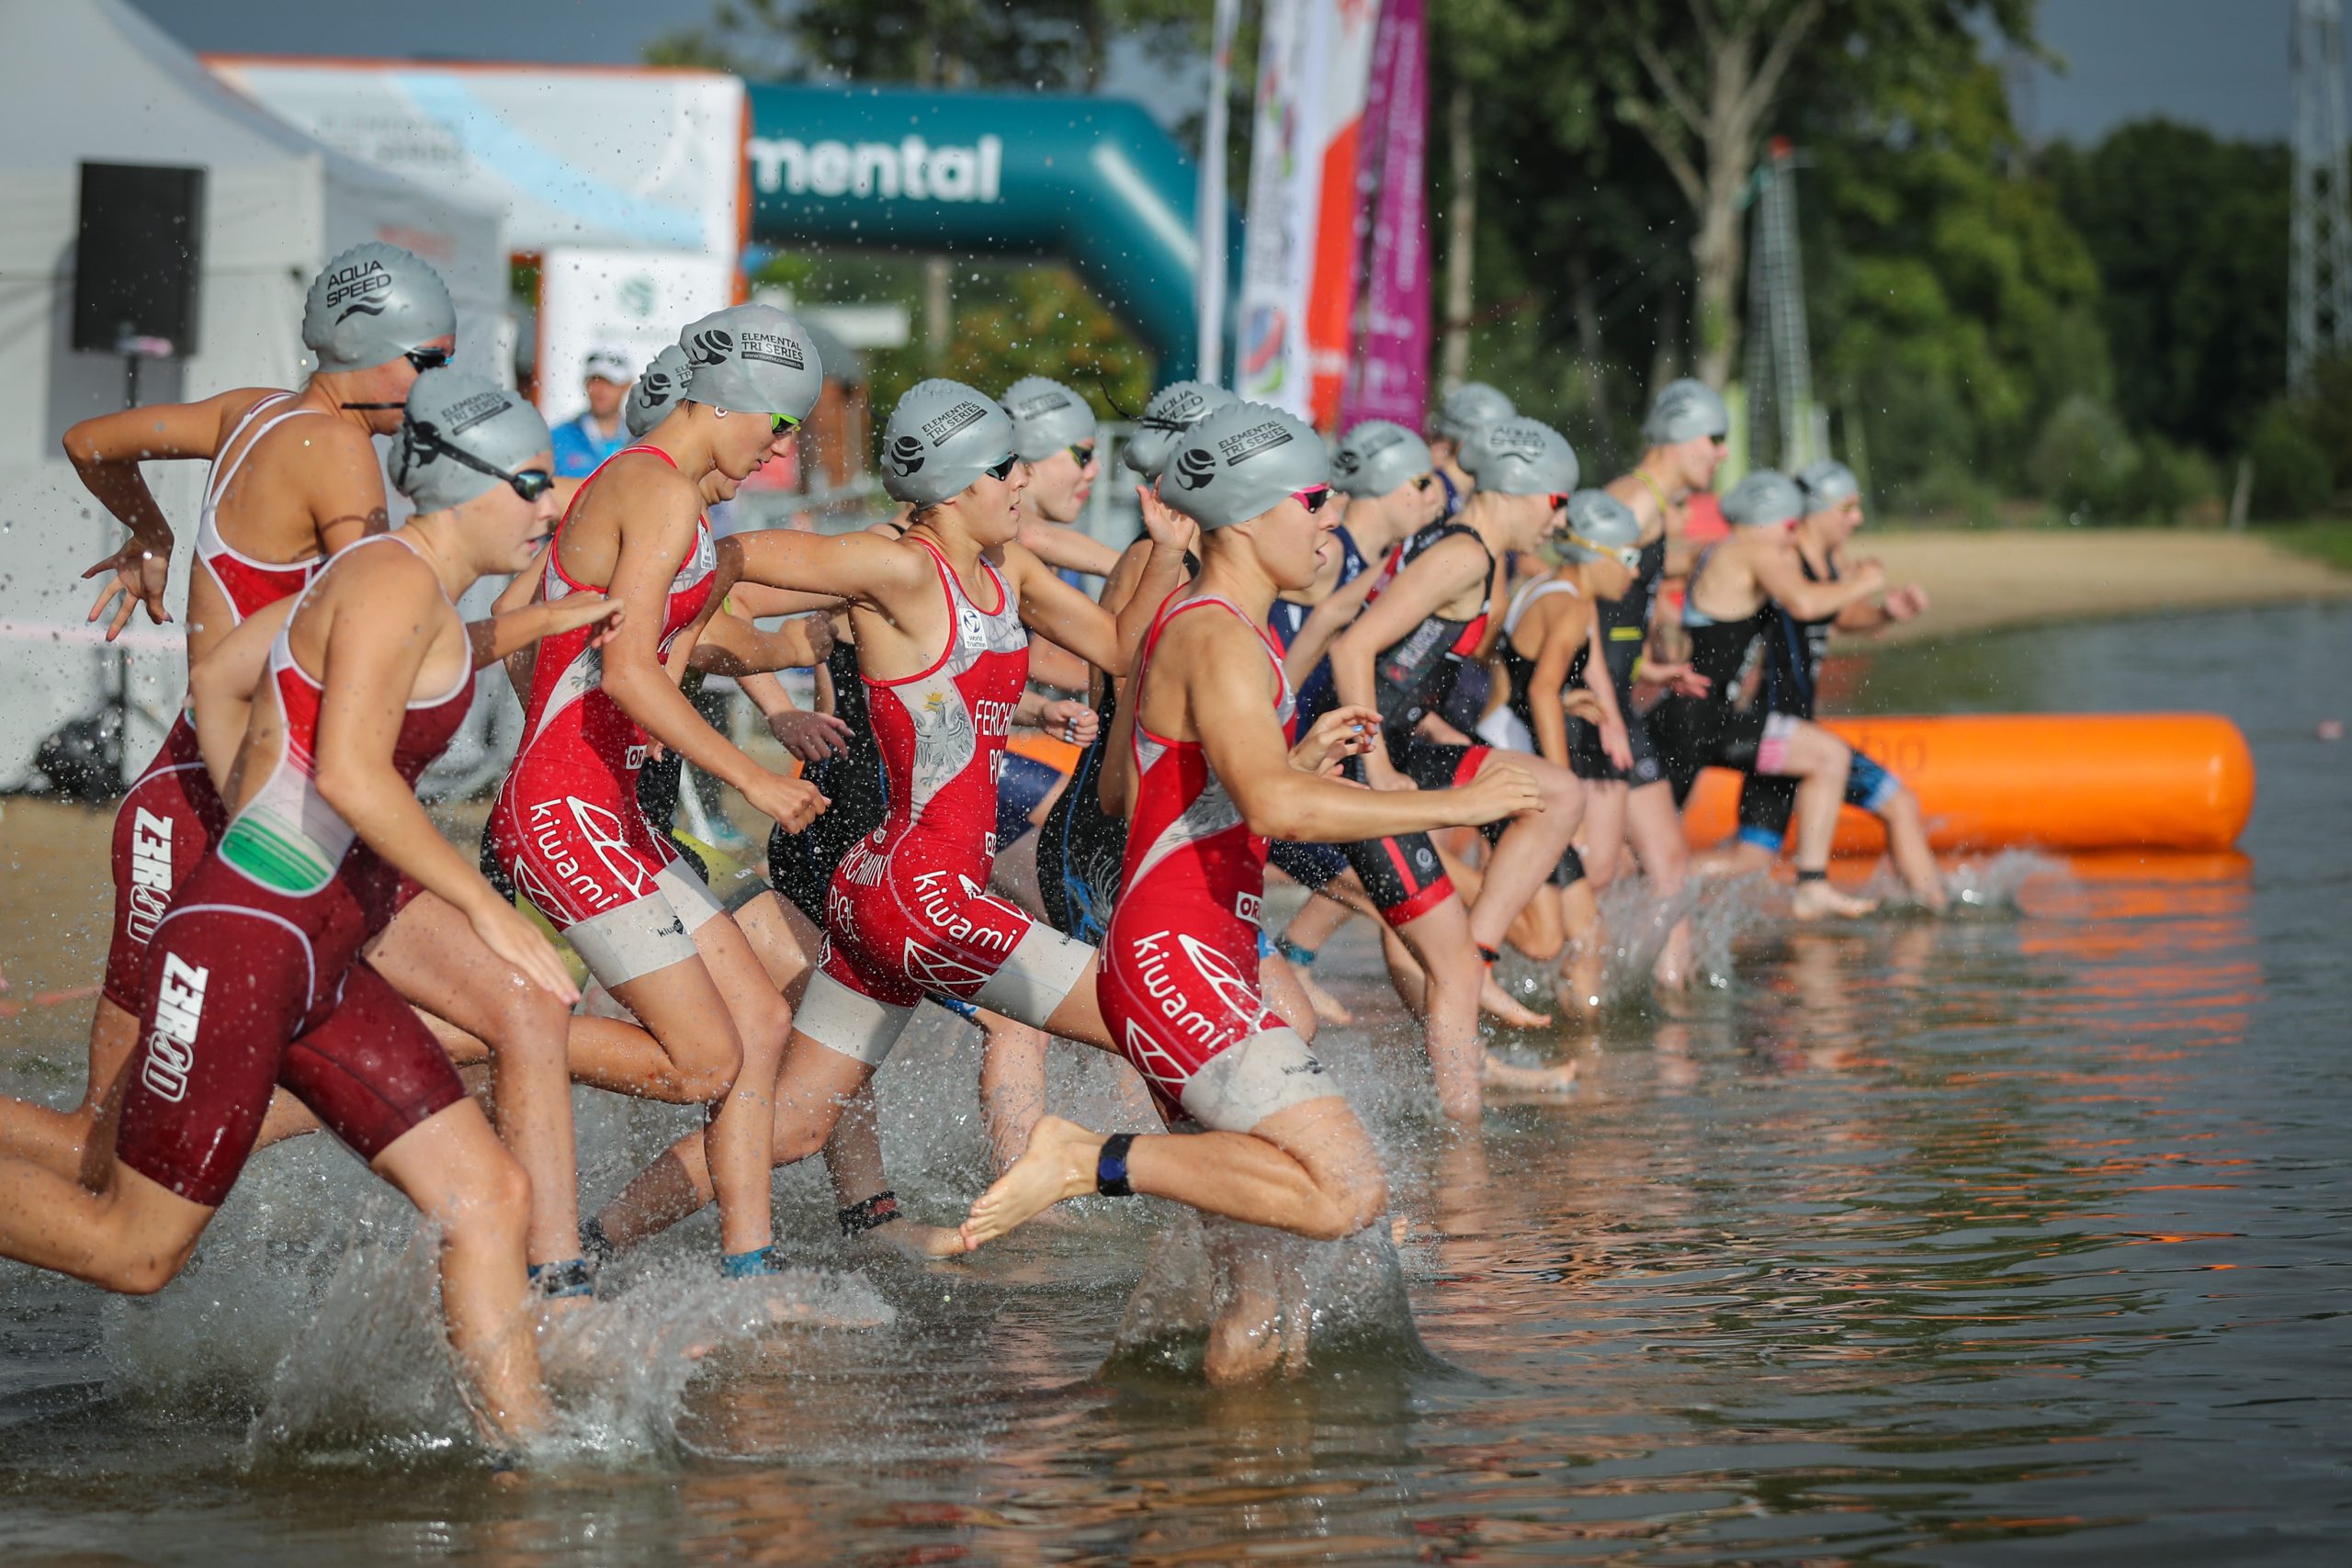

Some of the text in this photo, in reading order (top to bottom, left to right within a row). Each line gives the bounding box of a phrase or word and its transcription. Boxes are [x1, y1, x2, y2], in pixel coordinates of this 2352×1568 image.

[747, 134, 1003, 202] mental
[326, 274, 391, 308] SPEED
[327, 260, 384, 290] AQUA
[741, 333, 802, 351] ELEMENTAL
[741, 341, 804, 361] TRI SERIES
[922, 400, 973, 433] ELEMENTAL
[926, 424, 947, 439] TRI
[946, 403, 980, 427] SERIES
[1218, 420, 1281, 449] ELEMENTAL
[1221, 443, 1245, 457] TRI
[1247, 425, 1287, 447] SERIES
[529, 798, 620, 909] kiwami
[912, 870, 1018, 953] kiwami
[1133, 930, 1236, 1050] kiwami
